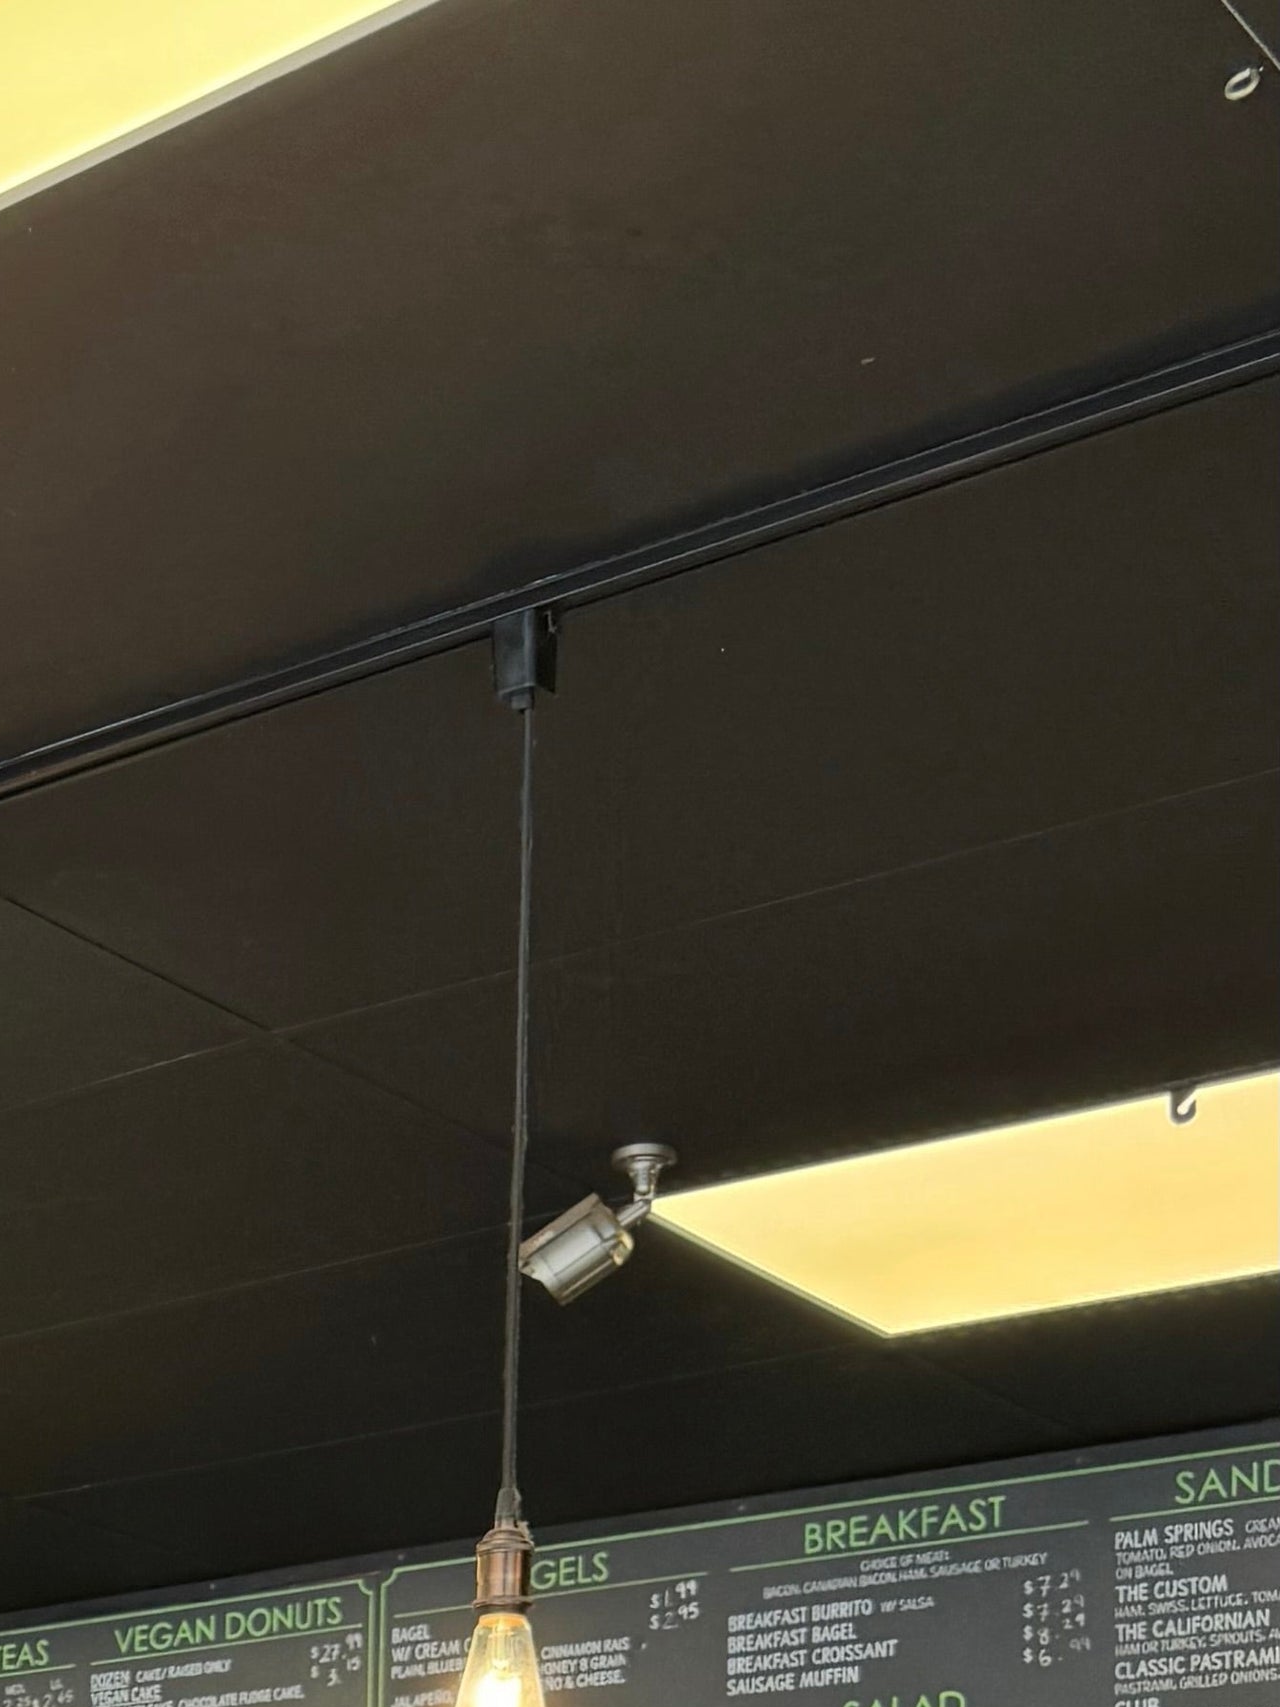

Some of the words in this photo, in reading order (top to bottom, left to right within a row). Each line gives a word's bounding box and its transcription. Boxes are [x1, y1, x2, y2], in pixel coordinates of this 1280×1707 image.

[1175, 1458, 1280, 1504] SAND
[804, 1495, 1007, 1554] BREAKFAST
[1115, 1528, 1158, 1549] PALM
[1164, 1518, 1234, 1544] SPRINGS
[1003, 1552, 1047, 1567] TURKEY
[1170, 1544, 1194, 1558] RED
[530, 1551, 610, 1590] GELS
[1115, 1582, 1149, 1603] THE
[1154, 1575, 1228, 1599] CUSTOM
[114, 1614, 215, 1653] VEGAN
[225, 1596, 342, 1640] DONUTS
[728, 1606, 807, 1632] BREAKFAST
[811, 1599, 873, 1622] BURRITO
[1114, 1622, 1147, 1643] THE
[1152, 1608, 1270, 1637] CALIFORNIAN
[392, 1624, 430, 1644] BAGEL
[415, 1640, 459, 1660] CREAM
[727, 1627, 807, 1654] BREAKFAST
[811, 1622, 857, 1643] BAGEL
[727, 1650, 807, 1675] BREAKFAST
[811, 1639, 898, 1665] CROISSANT
[1115, 1656, 1186, 1679] CLASSIC
[1190, 1646, 1280, 1672] PASTRAMI
[91, 1690, 129, 1707] VEGAN
[131, 1684, 162, 1701] CAKE
[727, 1672, 795, 1696] SAUSAGE
[800, 1666, 859, 1688] MUFFIN
